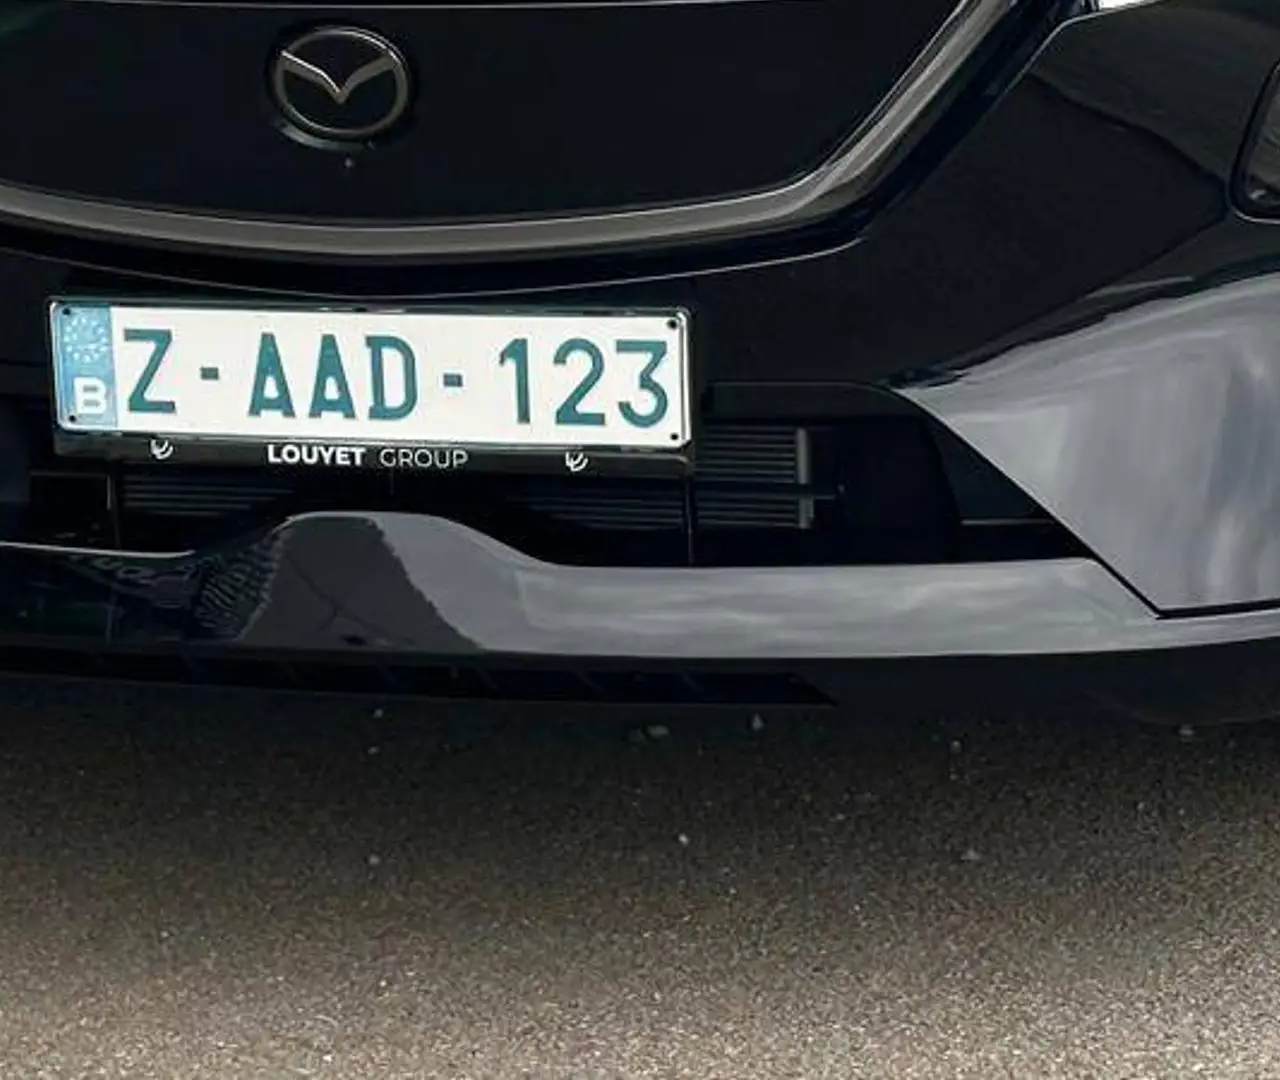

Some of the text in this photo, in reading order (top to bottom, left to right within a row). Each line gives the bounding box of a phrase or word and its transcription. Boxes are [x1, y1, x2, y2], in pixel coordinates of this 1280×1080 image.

[73, 377, 107, 415] B
[267, 444, 469, 469] LOUYET GROUP
